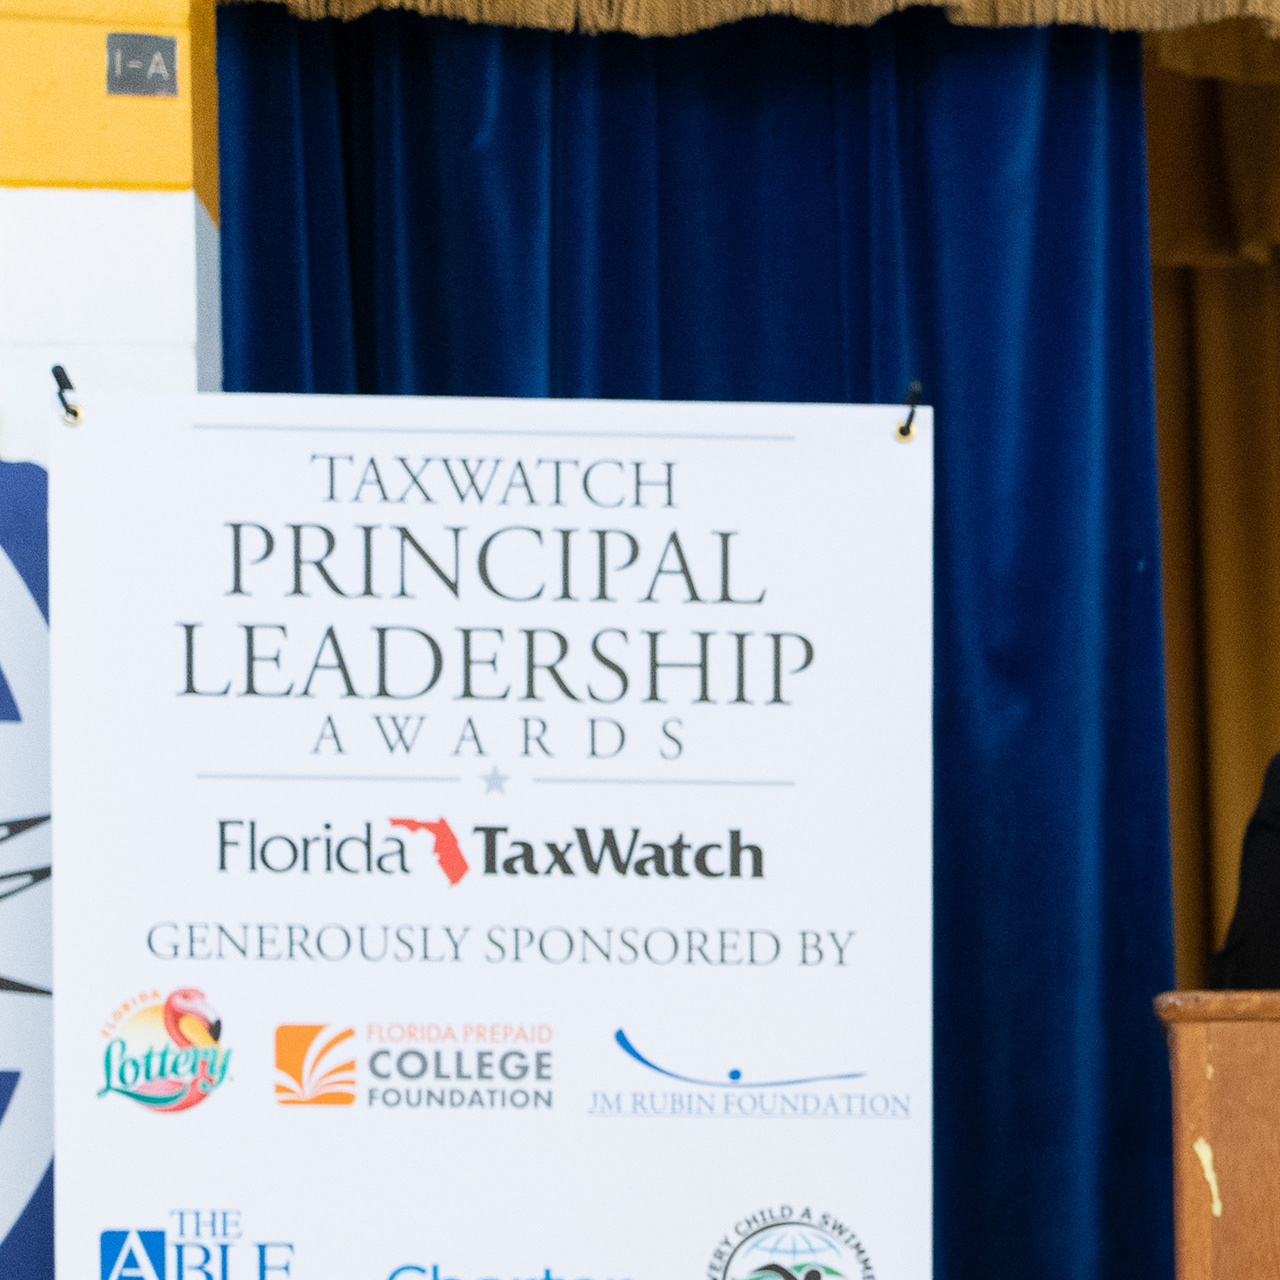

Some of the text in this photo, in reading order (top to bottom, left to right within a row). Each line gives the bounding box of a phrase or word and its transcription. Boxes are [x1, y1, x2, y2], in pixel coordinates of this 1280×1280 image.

[310, 453, 680, 509] TAXWATCH
[223, 521, 768, 606] PRINCIPAL
[174, 620, 816, 706] LEADERSHIP
[311, 713, 686, 760] AWARDS
[217, 819, 766, 880] Florida TaxWatch
[146, 921, 856, 967] GENEROUSLY SPONSORED BY
[101, 989, 161, 1039] FLORIDA
[367, 1022, 553, 1044] FLORIDA PREPAID
[96, 1036, 233, 1106] Lottery
[368, 1049, 553, 1081] COLLEGE
[367, 1087, 553, 1110] FOUNDATION
[588, 1091, 912, 1118] JM RUBIN FOUNDATION
[170, 1208, 242, 1239] THE
[734, 1204, 793, 1237] CHILD
[801, 1206, 812, 1221] A
